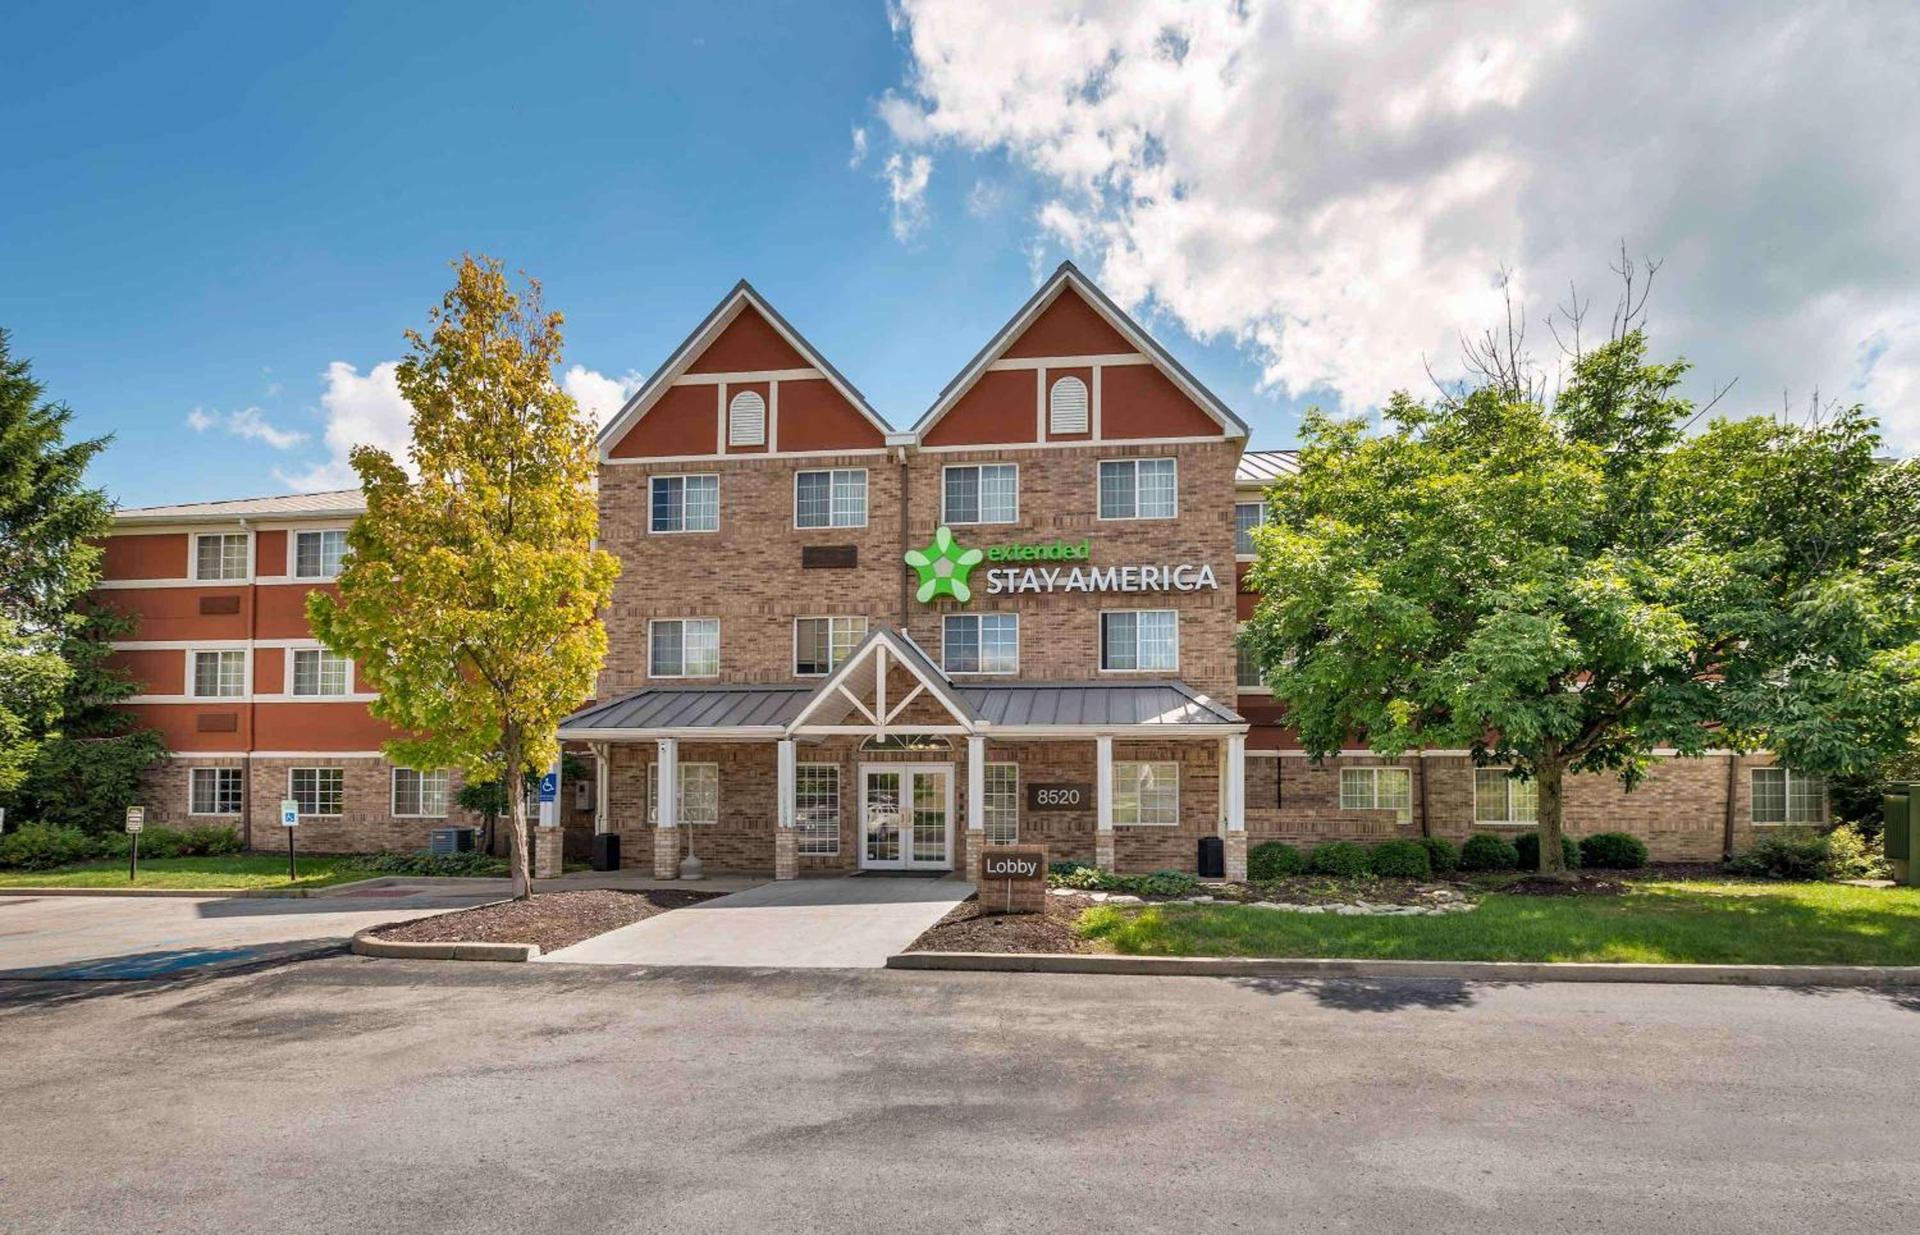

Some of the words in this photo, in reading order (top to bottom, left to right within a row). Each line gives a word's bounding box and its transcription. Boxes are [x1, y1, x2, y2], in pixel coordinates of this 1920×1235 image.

[988, 539, 1090, 562] extended
[986, 567, 1059, 594] STAY
[1065, 564, 1218, 592] AMERICA
[1037, 789, 1080, 805] 8520
[986, 858, 1037, 876] Lobby
